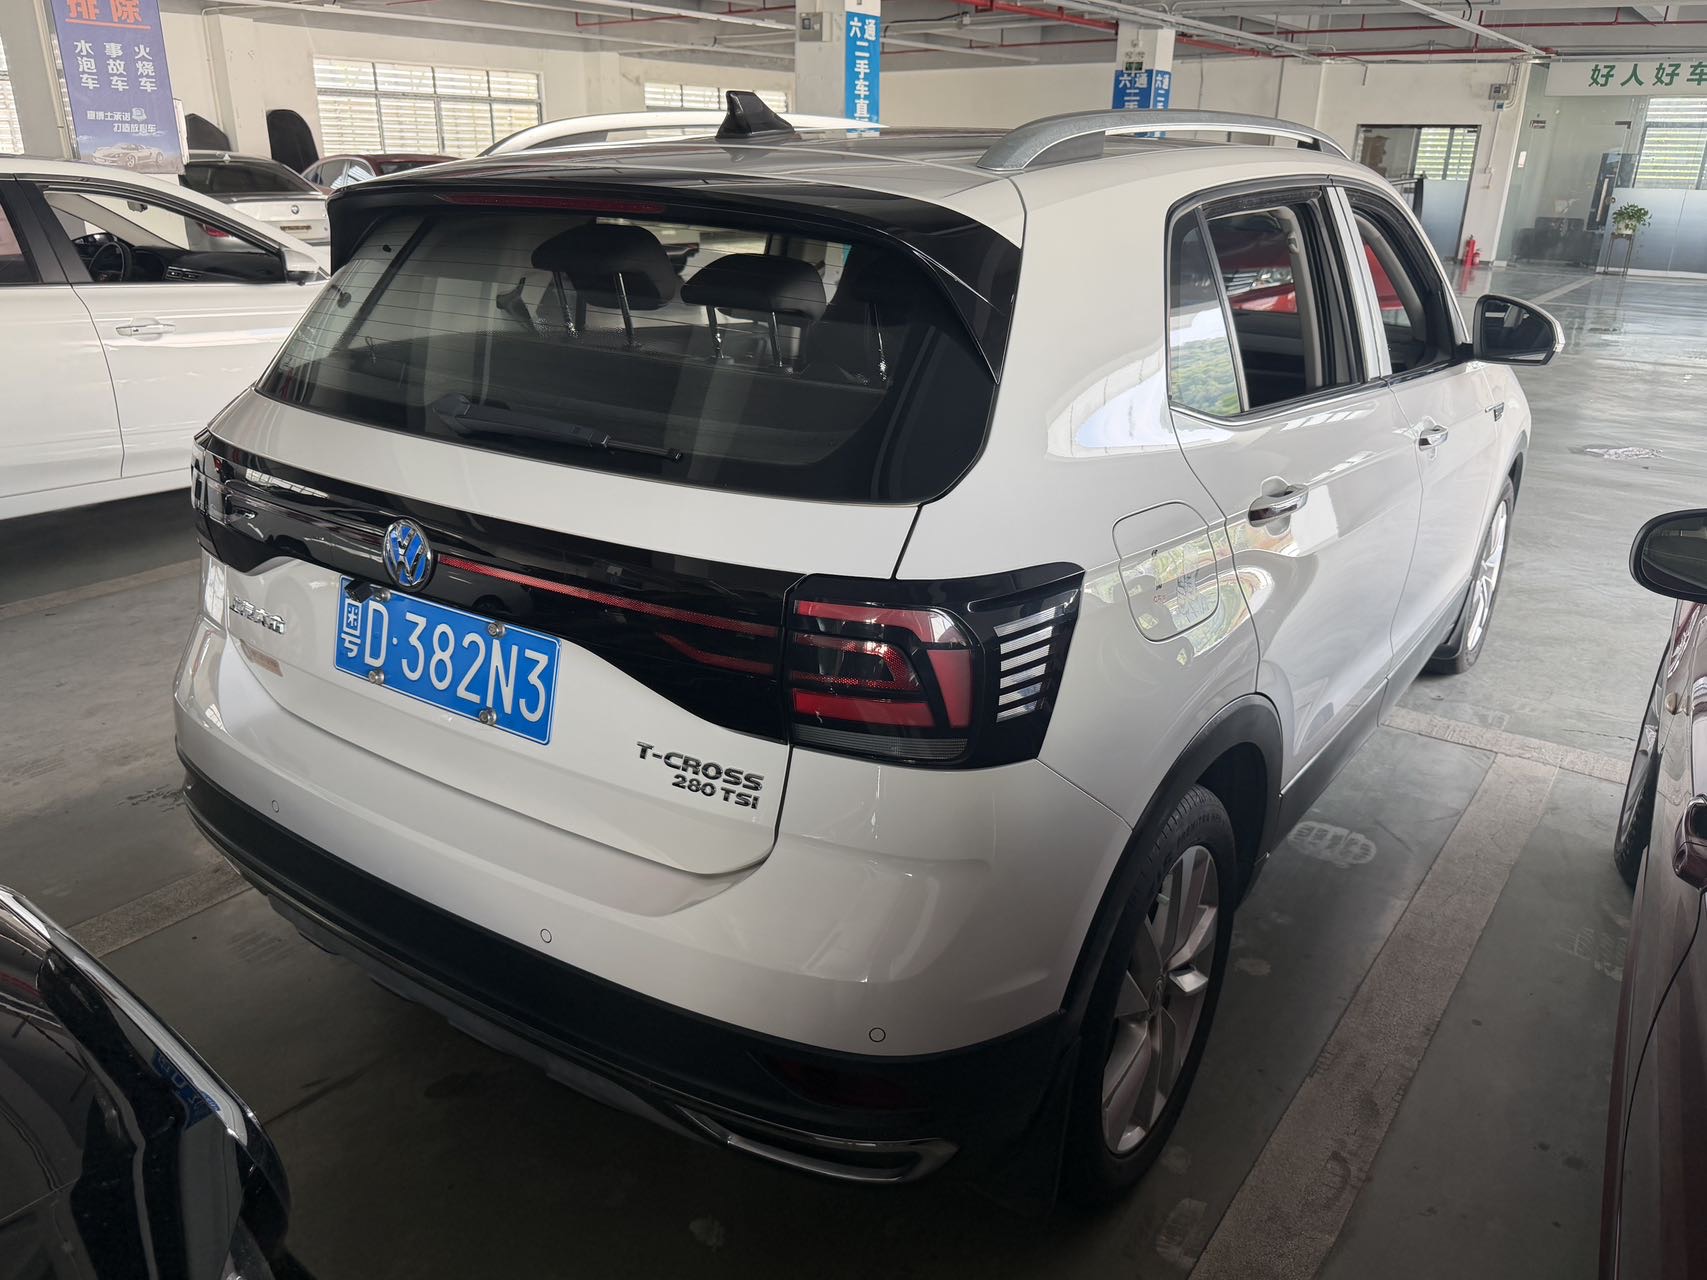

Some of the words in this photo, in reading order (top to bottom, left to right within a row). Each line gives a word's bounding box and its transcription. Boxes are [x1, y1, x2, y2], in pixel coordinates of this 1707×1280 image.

[66, 0, 142, 23] 排除
[849, 16, 876, 41] 六通
[73, 39, 100, 90] 水泡车
[103, 42, 129, 91] 事故车
[134, 44, 157, 92] 火烧车
[1119, 72, 1148, 89] 六通
[1588, 61, 1707, 87] 好人好车
[636, 741, 764, 792] T-CROSS
[672, 774, 717, 797] 280
[721, 787, 760, 810] TSI
